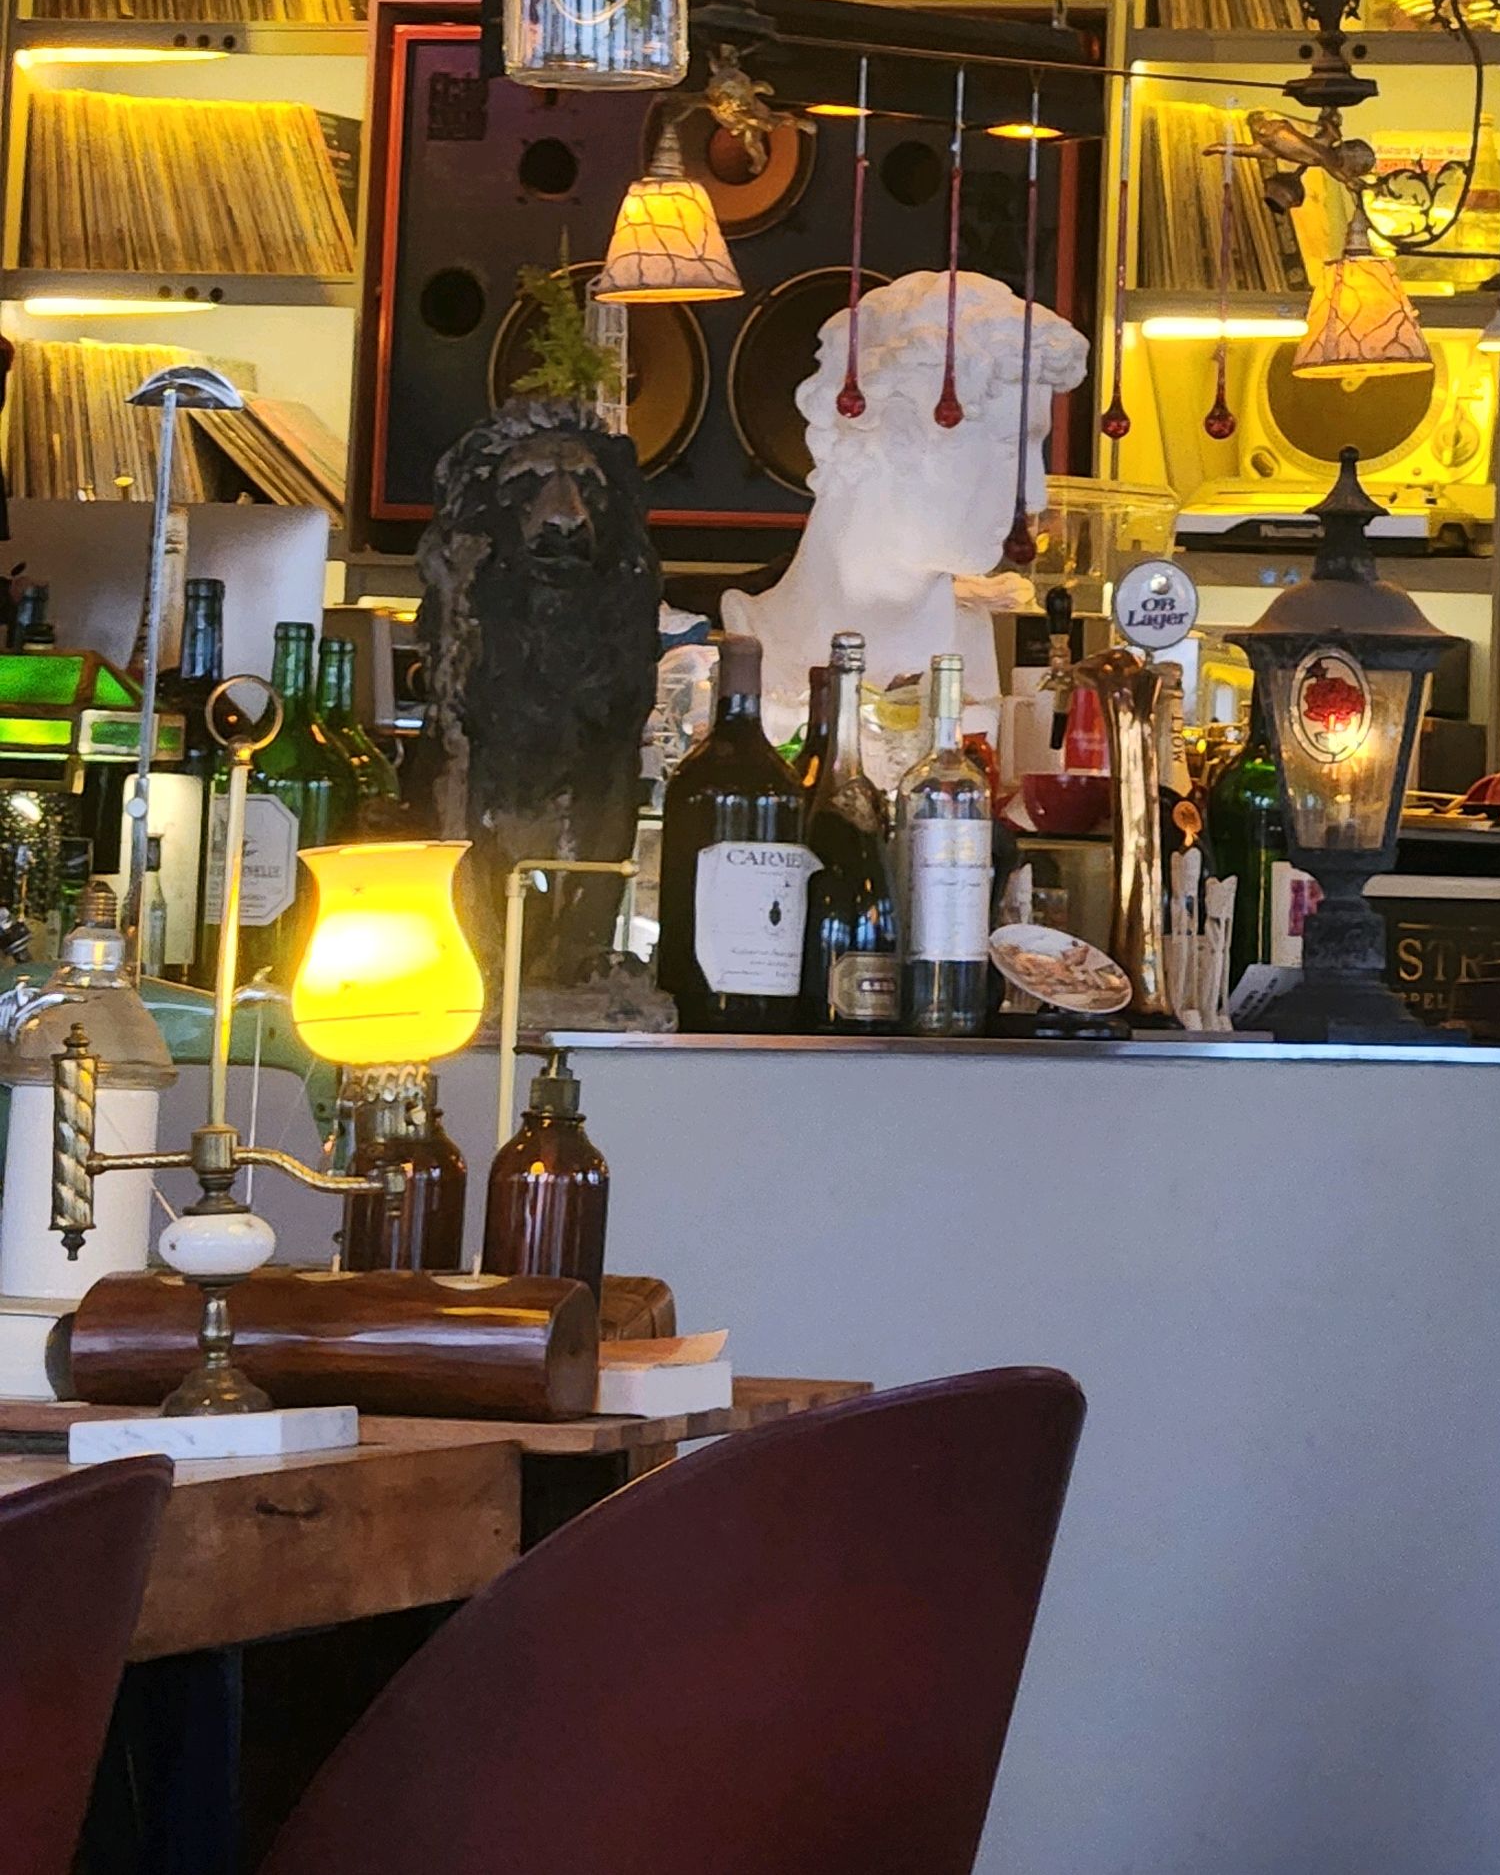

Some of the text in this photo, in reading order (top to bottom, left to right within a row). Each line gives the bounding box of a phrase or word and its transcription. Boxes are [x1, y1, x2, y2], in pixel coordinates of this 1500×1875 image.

[1141, 597, 1176, 612] OB
[1125, 609, 1189, 630] Lager
[726, 849, 807, 870] CARME
